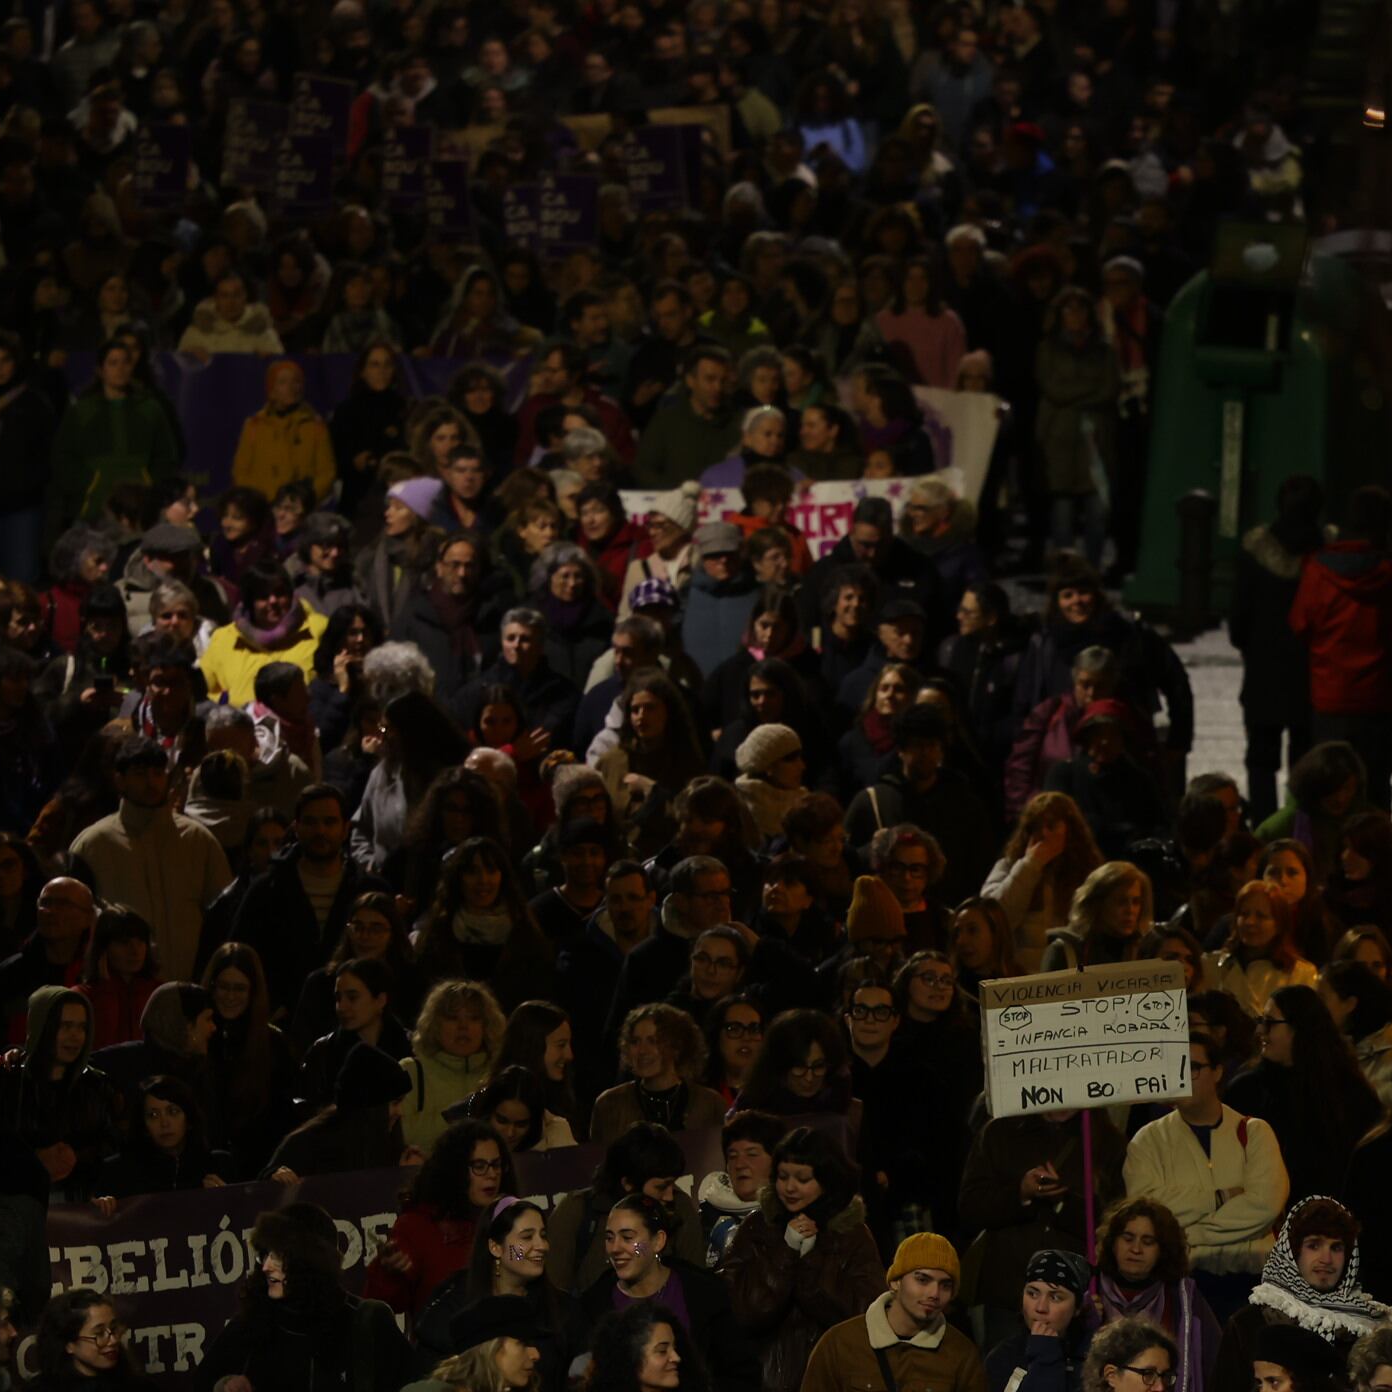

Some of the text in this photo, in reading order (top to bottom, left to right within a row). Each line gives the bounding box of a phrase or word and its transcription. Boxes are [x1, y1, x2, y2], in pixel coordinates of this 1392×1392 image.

[1004, 1011, 1029, 1023] STOP
[1143, 1000, 1172, 1011] STOP
[1013, 1047, 1162, 1078] MALTRATADOR
[1021, 1085, 1064, 1109] NON
[1087, 1081, 1115, 1098] BO
